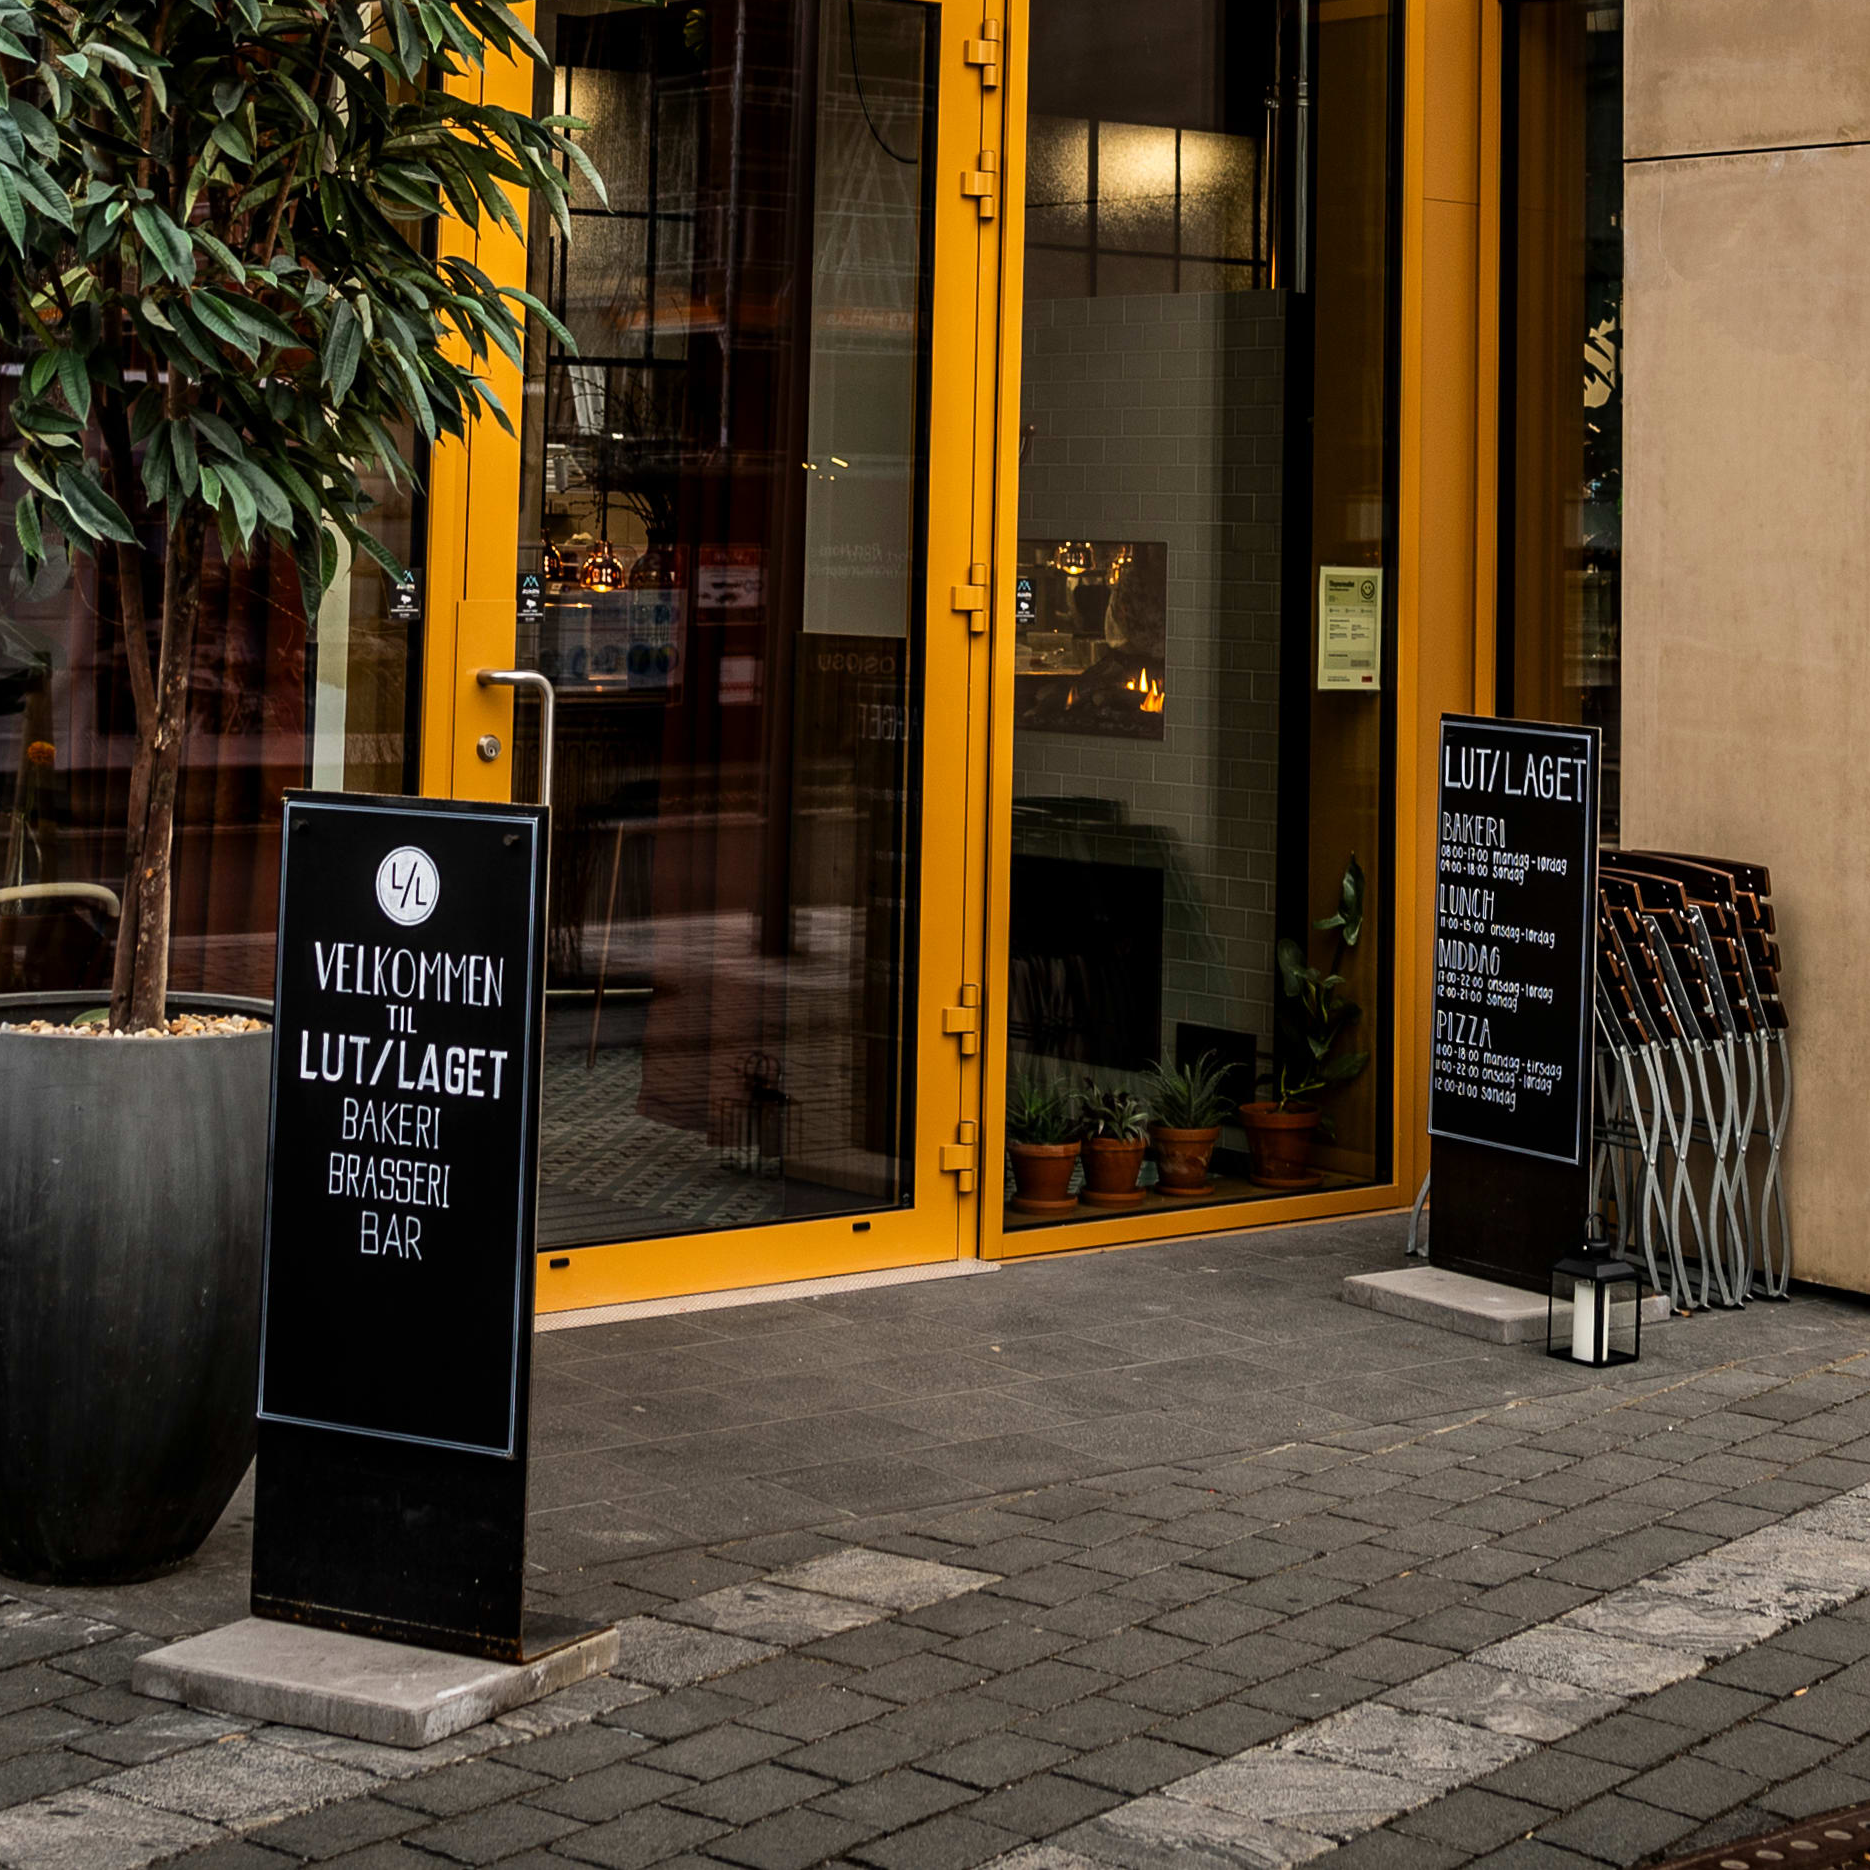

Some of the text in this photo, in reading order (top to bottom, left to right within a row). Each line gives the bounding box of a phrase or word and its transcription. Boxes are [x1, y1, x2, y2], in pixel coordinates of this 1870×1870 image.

[1444, 745, 1587, 803] LUT/LAGET
[1442, 811, 1506, 848] BAKERI
[1439, 883, 1495, 921] LUNCH
[314, 940, 505, 1008] VELKOMMEN
[1438, 938, 1500, 977] MIDDAG
[385, 1004, 418, 1034] TIL
[1436, 1009, 1492, 1050] PIZZA
[299, 1030, 509, 1100] LUT/LAGET
[341, 1097, 441, 1150] BAKERI
[328, 1151, 451, 1209] BRASSERI
[360, 1210, 422, 1261] BAR
